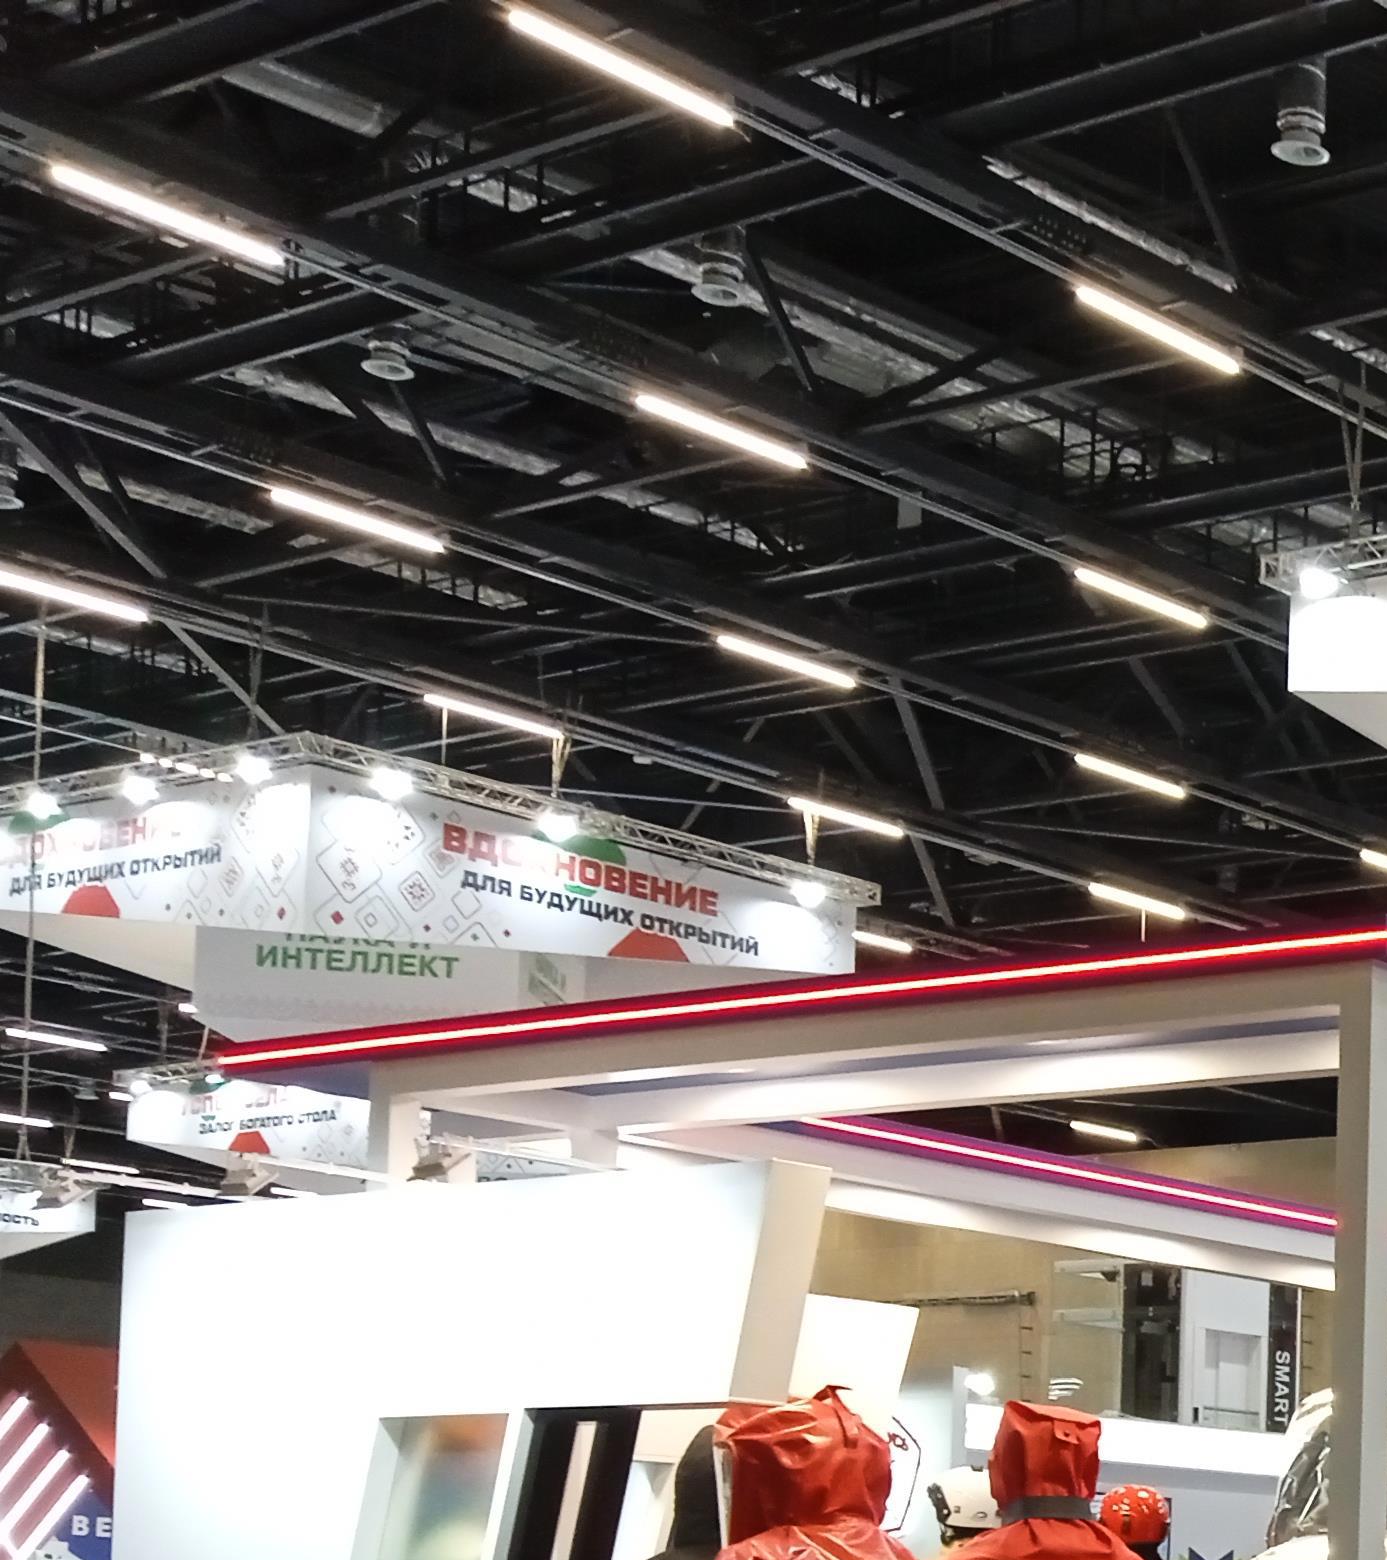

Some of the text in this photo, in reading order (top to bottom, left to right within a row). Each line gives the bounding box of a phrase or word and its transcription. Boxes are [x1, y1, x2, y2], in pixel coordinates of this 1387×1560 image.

[46, 860, 126, 889] БУДУЩИХ
[129, 842, 223, 876] ОТКРЫТИЙ
[461, 869, 759, 957] ДЛЯ БУДУЩИХ ОТКРЫТИЙ
[256, 943, 460, 979] ИНТЕЛЛЕКТ
[0, 1212, 40, 1227] ОСТЬ
[1273, 1349, 1292, 1427] SMART
